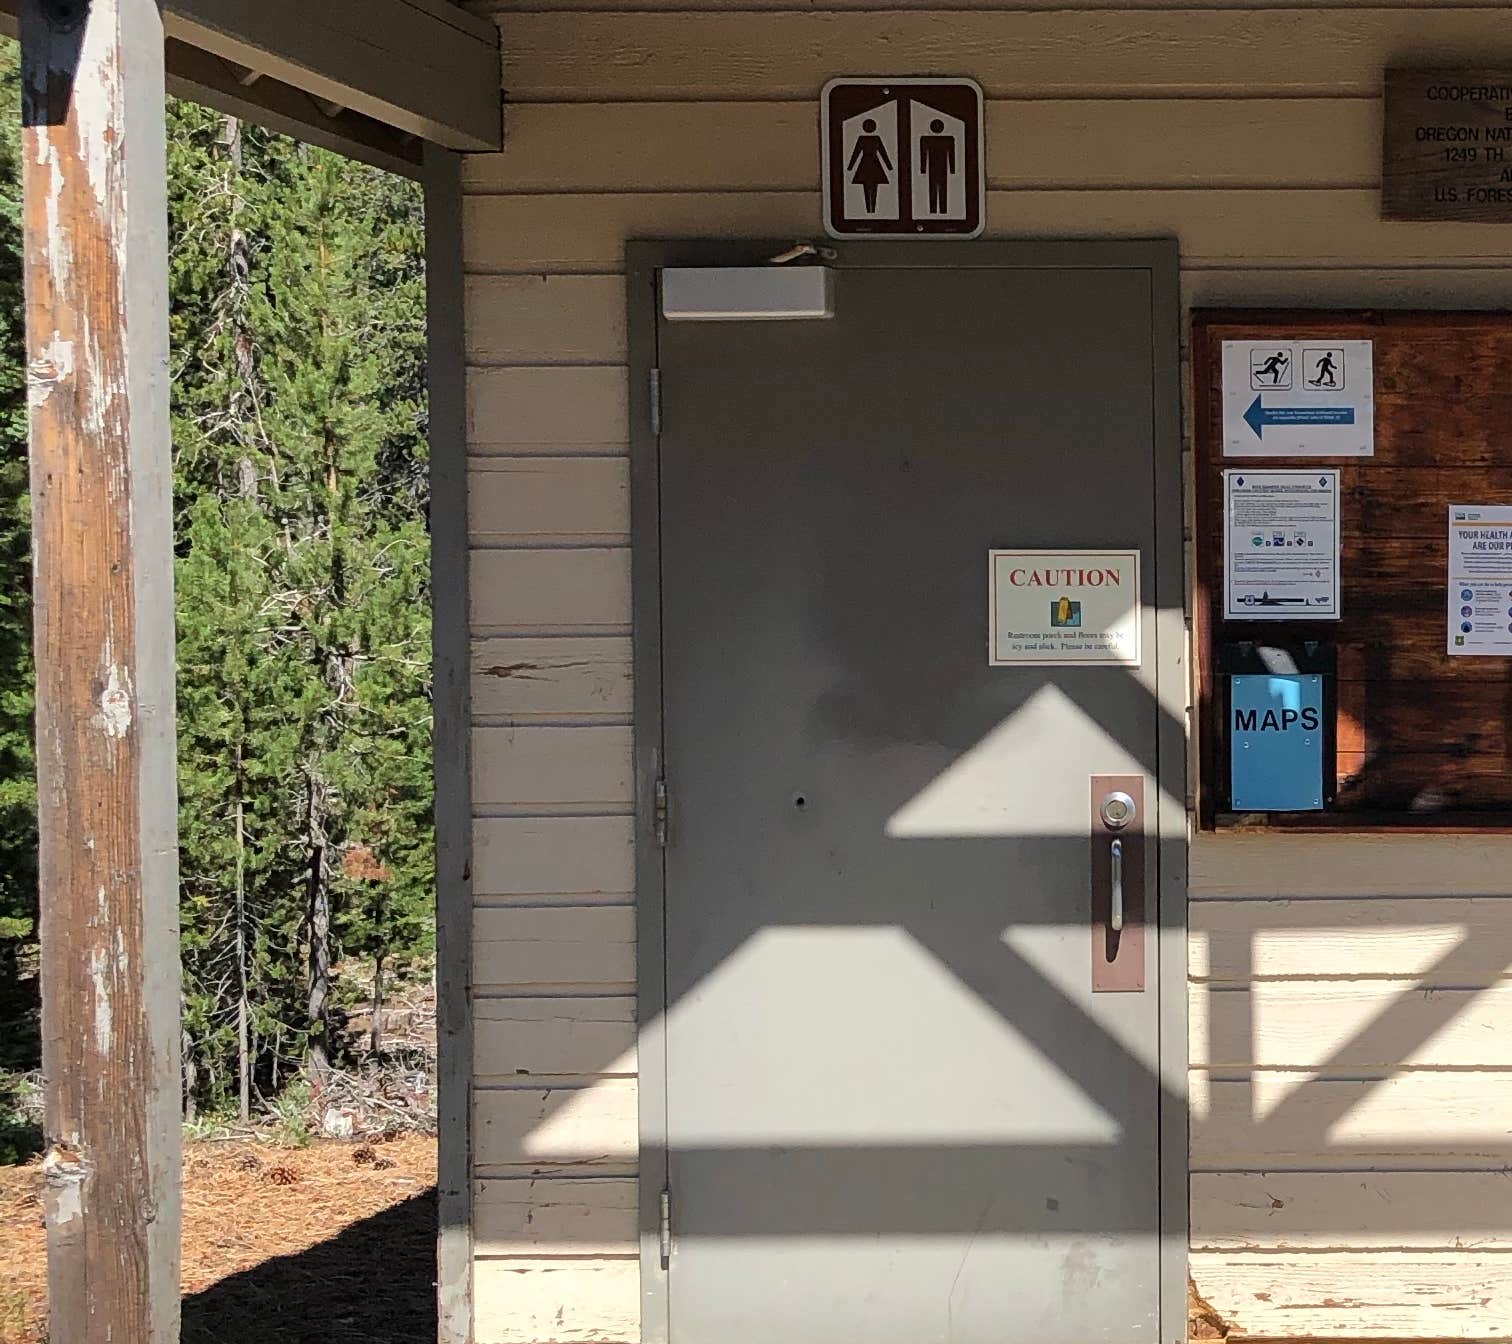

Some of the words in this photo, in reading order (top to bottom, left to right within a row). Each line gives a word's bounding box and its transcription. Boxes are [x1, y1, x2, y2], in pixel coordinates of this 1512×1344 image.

[1415, 127, 1479, 142] OREGON
[1445, 147, 1477, 163] 1249
[1434, 188, 1458, 203] U.S.
[1458, 530, 1479, 540] YOUR
[1481, 530, 1508, 540] HEALTH
[1472, 541, 1487, 550] ARE
[1488, 541, 1504, 551] OUR
[1009, 568, 1121, 587] CAUTION
[1235, 707, 1319, 731] MAPS
